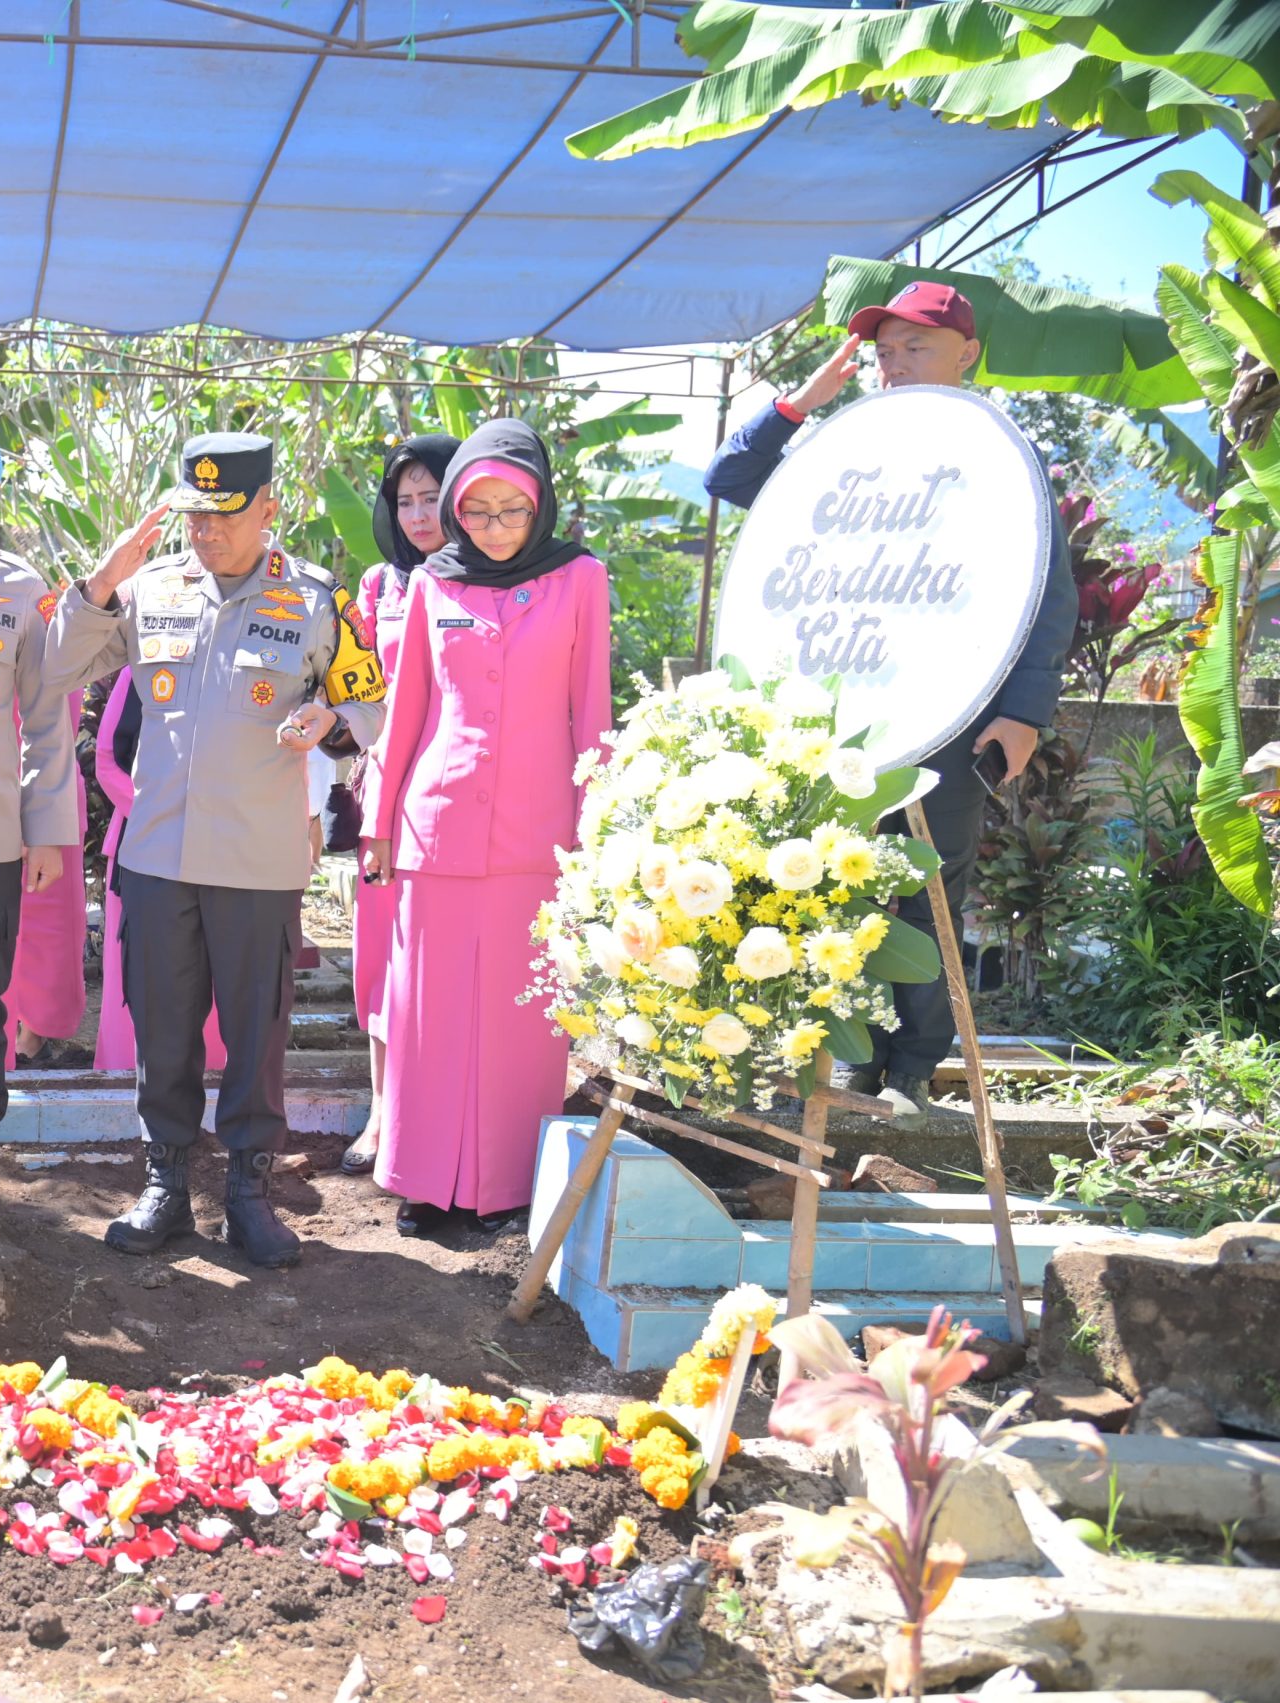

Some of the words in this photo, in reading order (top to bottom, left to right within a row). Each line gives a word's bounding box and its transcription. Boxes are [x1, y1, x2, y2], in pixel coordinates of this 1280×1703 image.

[812, 464, 961, 535] Turut
[762, 542, 964, 612] Berduka
[248, 623, 300, 645] POLRI
[796, 610, 889, 676] Cita
[361, 684, 382, 699] PATUH
